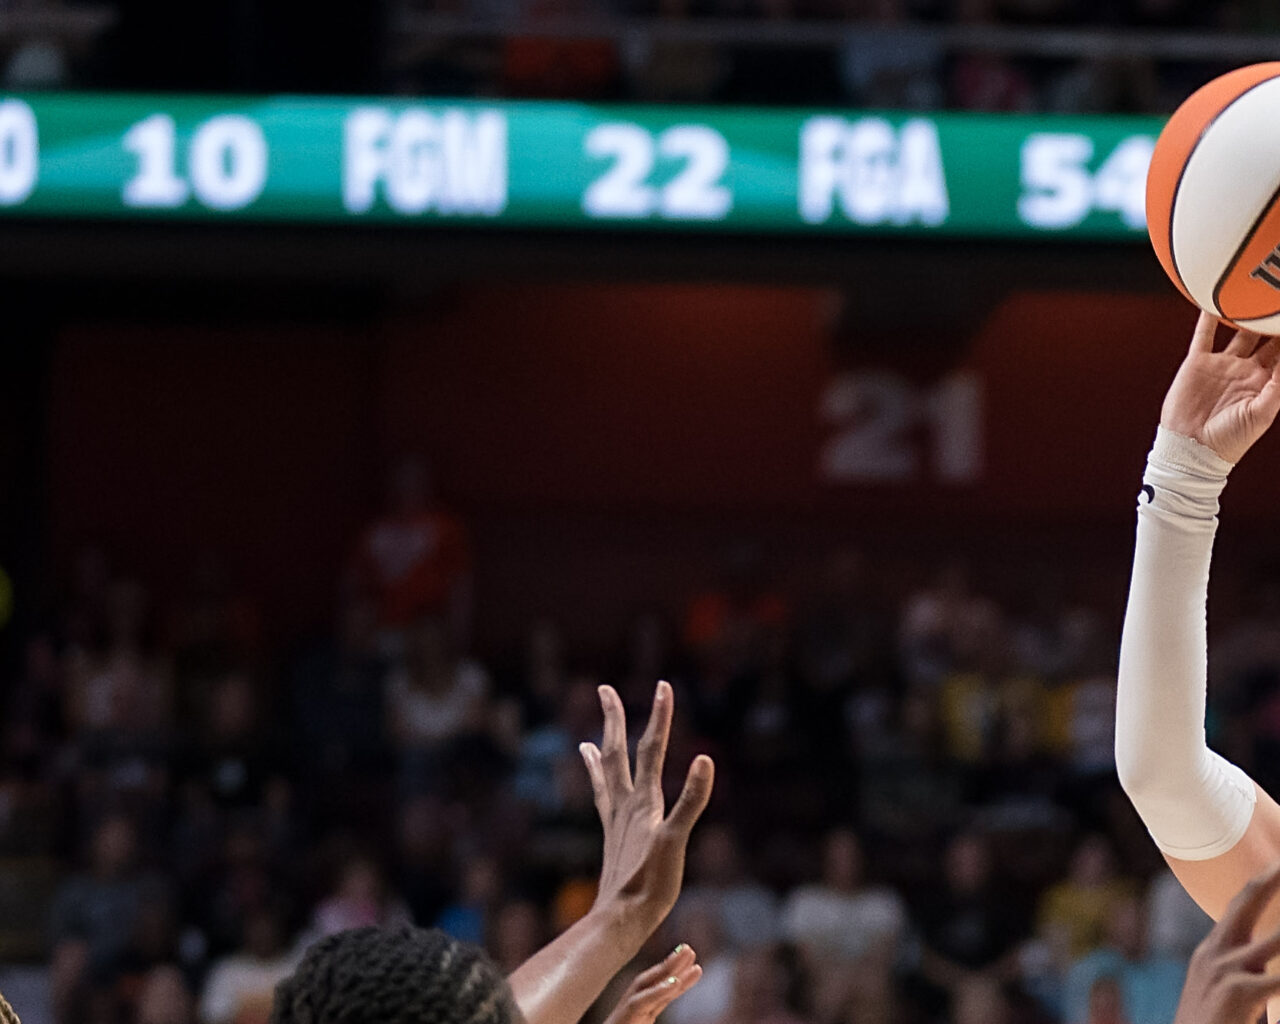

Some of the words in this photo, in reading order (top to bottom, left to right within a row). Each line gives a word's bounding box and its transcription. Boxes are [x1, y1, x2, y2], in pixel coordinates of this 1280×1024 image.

[121, 113, 269, 211] 10
[342, 106, 507, 216] FGM
[582, 122, 733, 220] 22
[798, 116, 950, 226] FGA
[1017, 133, 1147, 229] 54
[820, 369, 985, 482] 21
